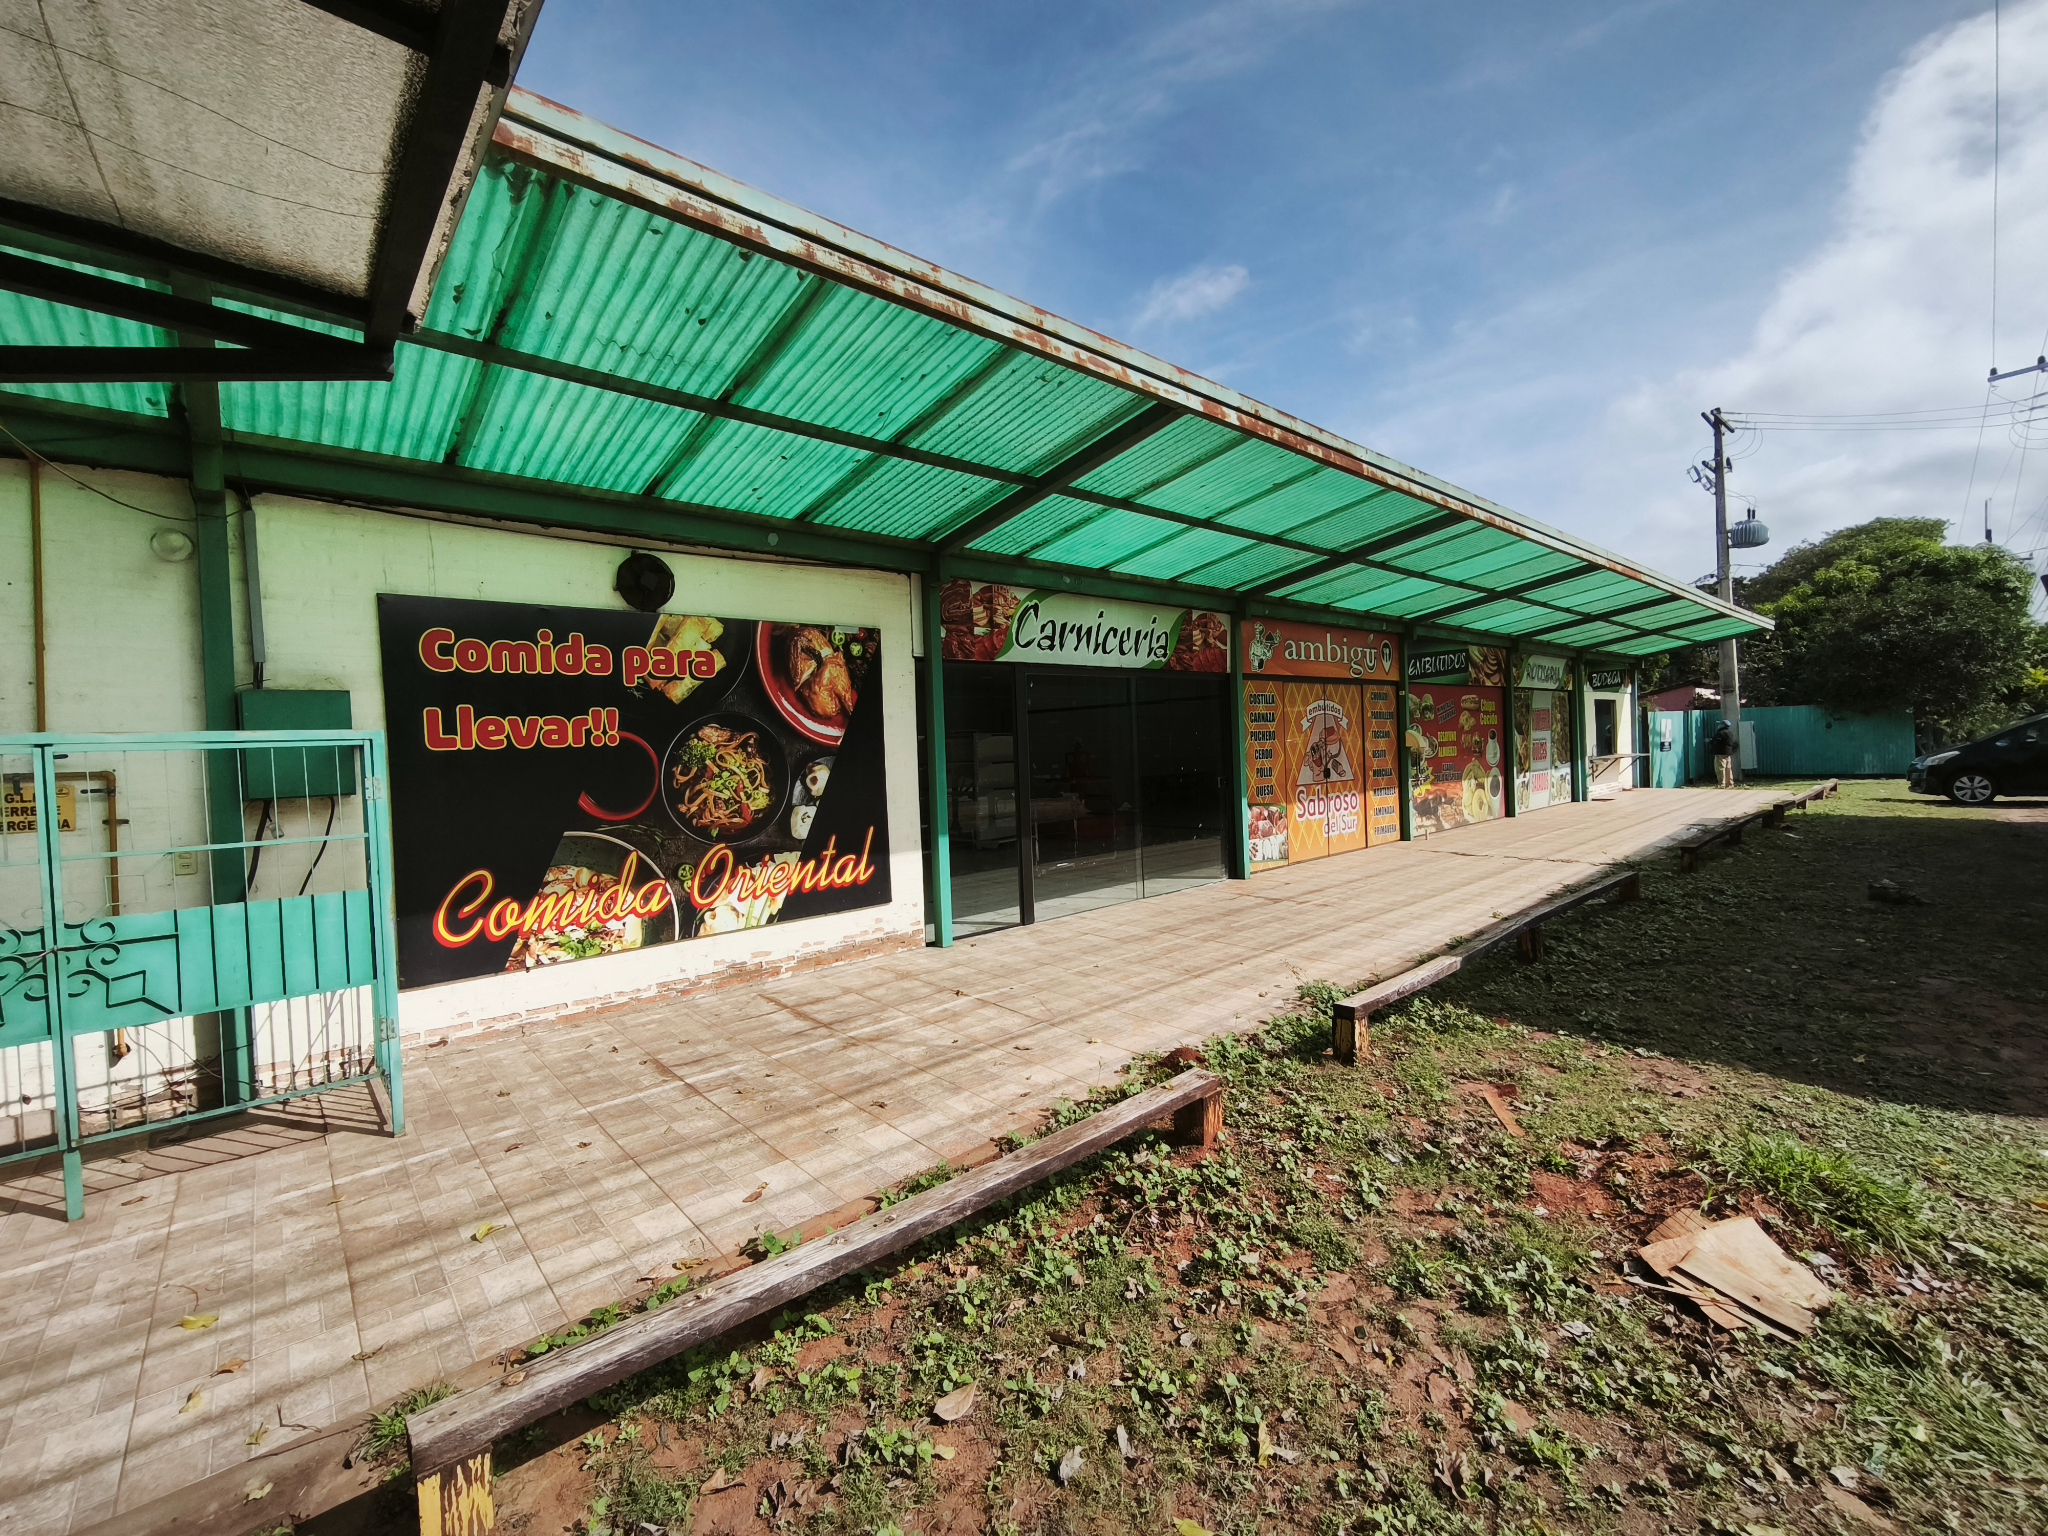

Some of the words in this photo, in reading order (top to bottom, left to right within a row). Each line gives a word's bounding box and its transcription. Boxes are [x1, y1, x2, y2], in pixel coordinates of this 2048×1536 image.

[419, 627, 613, 677] Comida
[622, 643, 718, 686] para
[1284, 632, 1377, 678] ambigú
[1591, 670, 1621, 688] BODEGA
[1249, 693, 1275, 705] COSTILLA
[1308, 702, 1341, 716] embutidos
[1249, 712, 1276, 724] CARNAZA
[423, 704, 621, 751] Llevar!!
[1250, 730, 1276, 742] PUCHERO
[1372, 730, 1390, 740] TOSCANO
[1255, 748, 1273, 760] CERDO
[1256, 766, 1273, 778] POLLO
[1255, 784, 1274, 798] QUESO
[1297, 788, 1358, 819] Sabroso
[1323, 816, 1339, 834] del
[1341, 814, 1356, 831] Sur
[432, 851, 671, 947] Comida
[689, 826, 875, 908] Oriental
